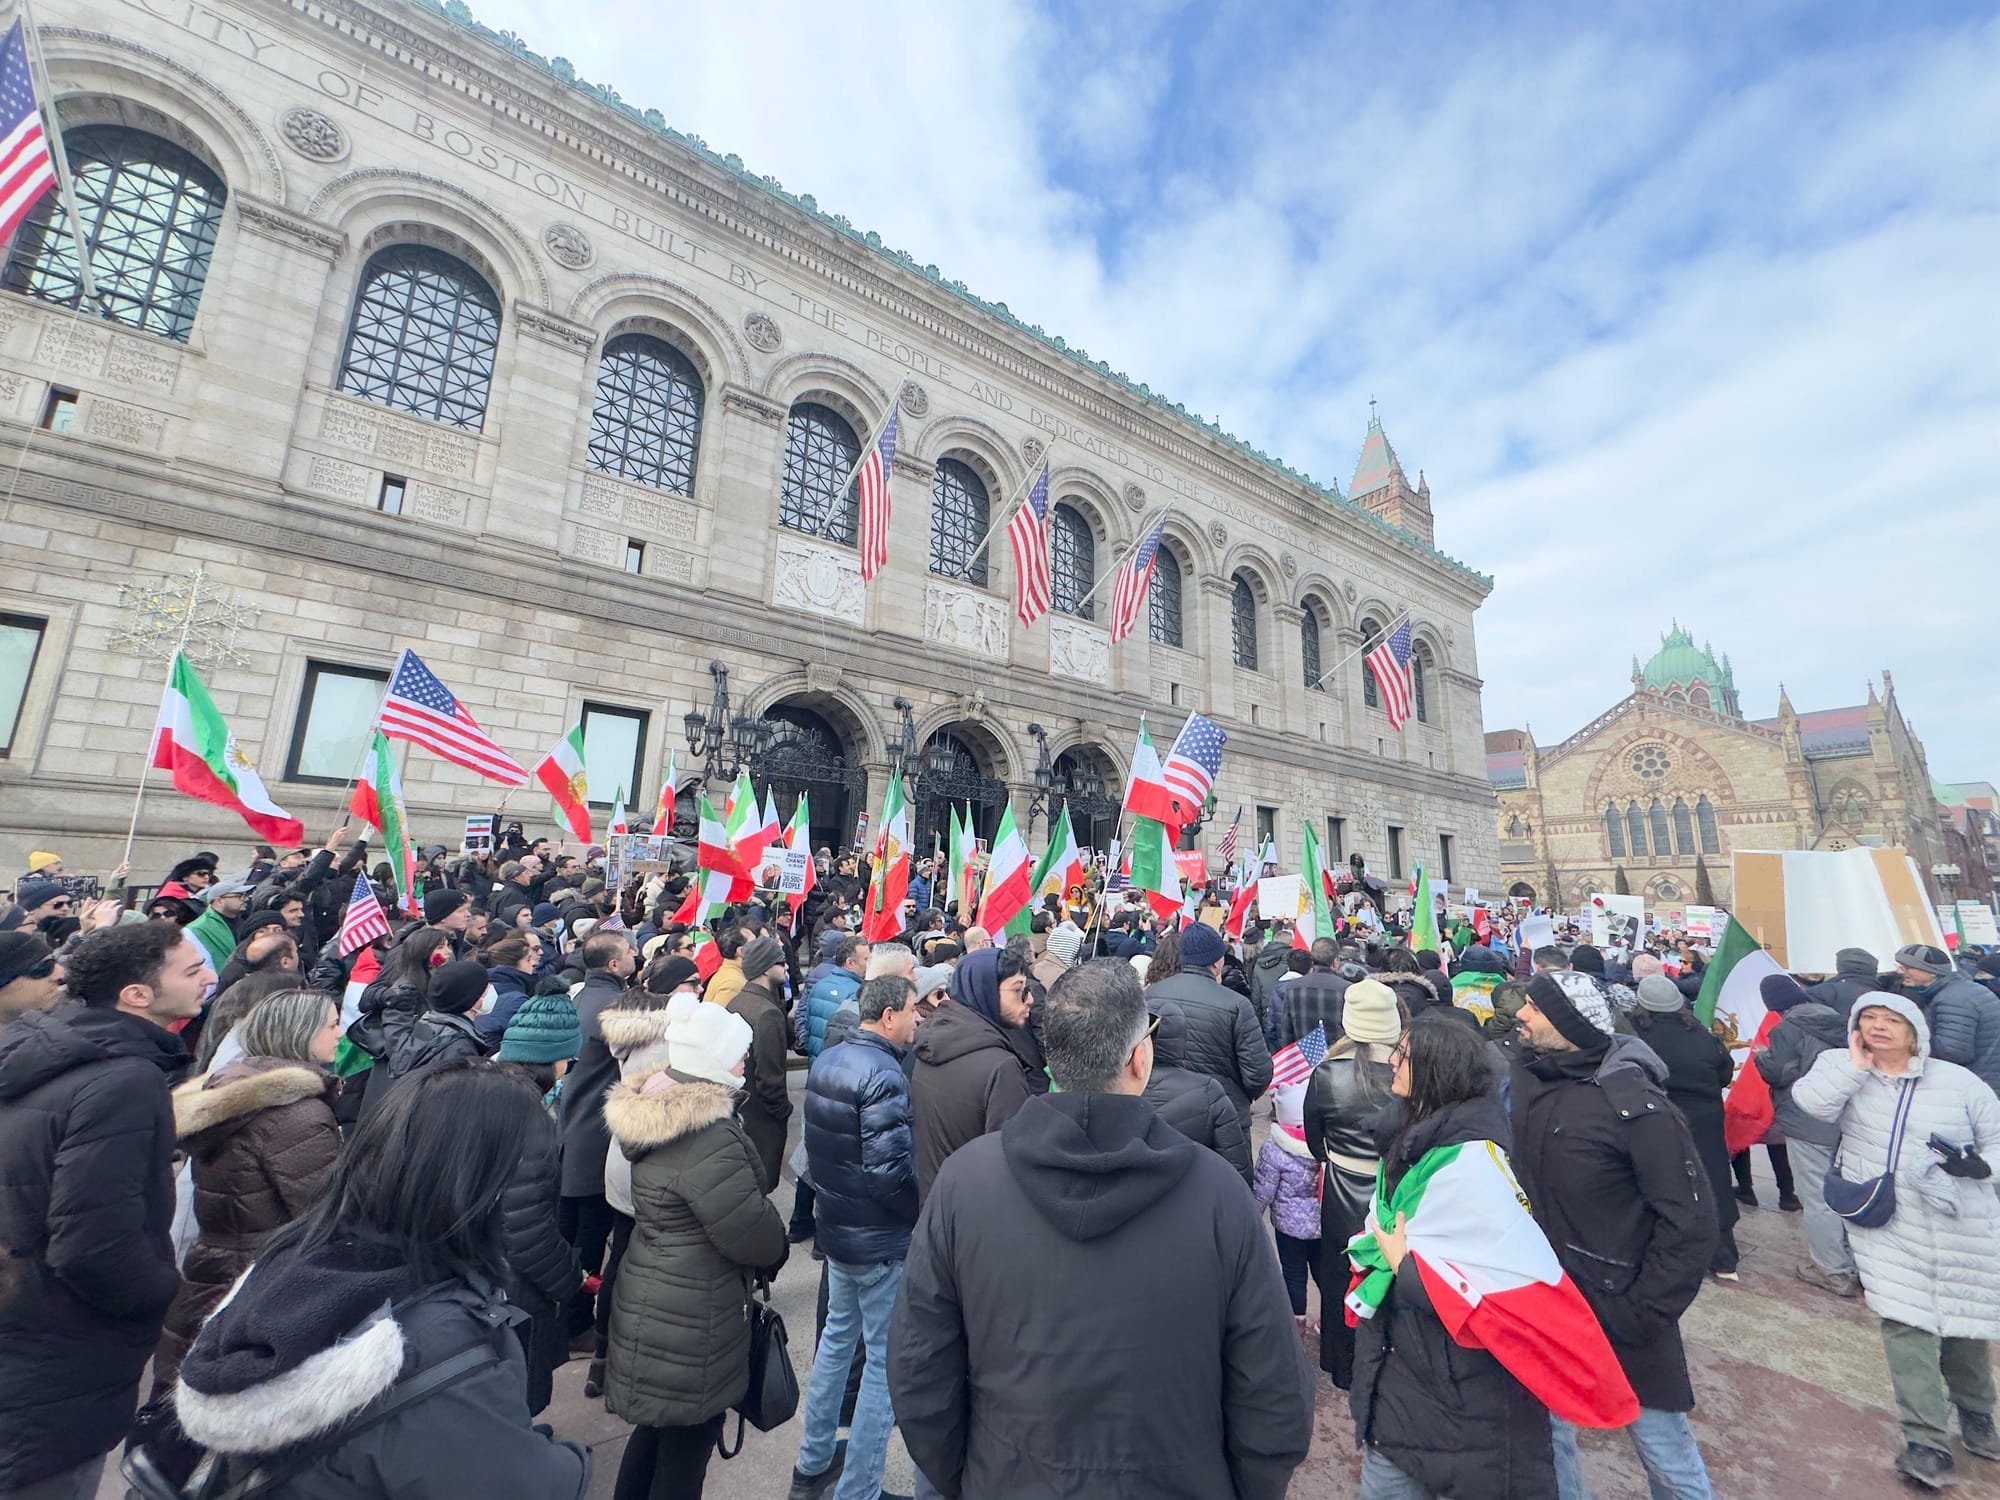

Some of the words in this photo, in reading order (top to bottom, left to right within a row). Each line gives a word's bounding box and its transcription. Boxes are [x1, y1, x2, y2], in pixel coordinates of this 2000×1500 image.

[318, 71, 384, 108] OF
[413, 112, 586, 211] BOSTON
[612, 207, 706, 263] BUILT
[729, 263, 768, 292] BY
[791, 292, 848, 335] THE
[866, 329, 952, 384] PEOPLE
[969, 381, 1012, 411] AND
[1030, 408, 1129, 466] DEDICATED
[1143, 461, 1163, 482] TO
[1174, 476, 1200, 499] THE
[1210, 495, 1299, 546] ADVANCEMENT
[1308, 541, 1322, 555] OF
[117, 336, 157, 354] COKE
[107, 372, 133, 385] FOX
[109, 362, 169, 385] CHATHAM
[94, 417, 144, 437] VATTEL
[324, 423, 373, 443] LALANDE
[317, 458, 353, 473] GALEN
[425, 460, 454, 473] EVANS
